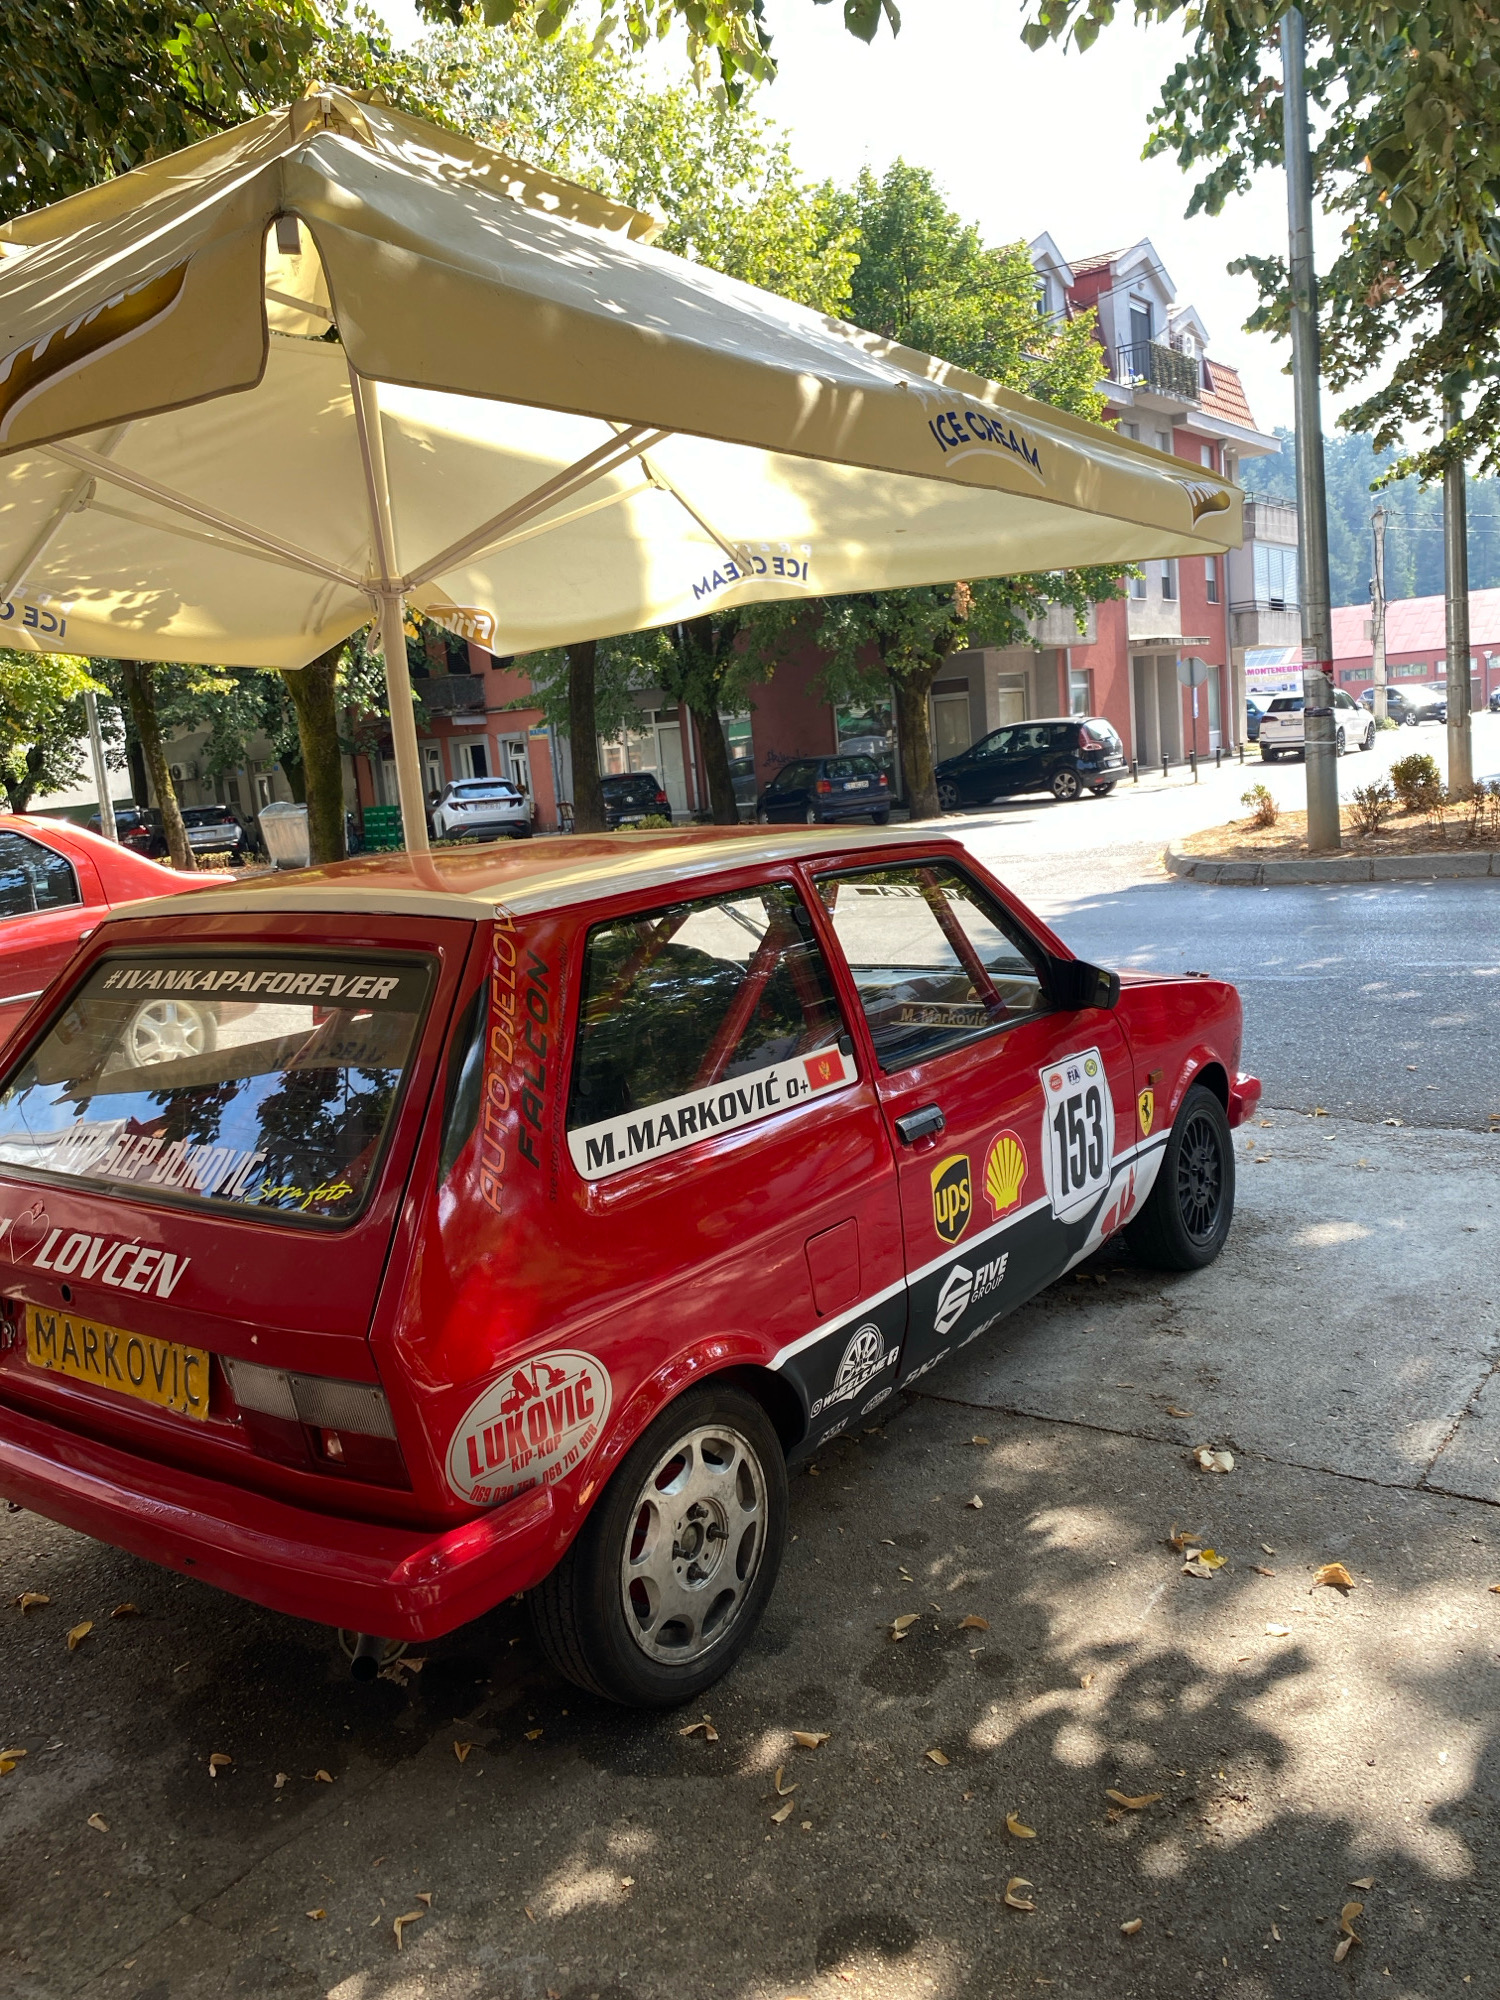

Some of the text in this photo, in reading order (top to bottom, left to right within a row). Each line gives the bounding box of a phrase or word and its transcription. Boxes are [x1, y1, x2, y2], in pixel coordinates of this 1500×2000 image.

[928, 411, 971, 453] ICE
[964, 411, 1044, 476] CREAM
[1245, 664, 1303, 676] MONTENEGRO
[103, 969, 400, 1000] #IVANKAPAFOREVER
[517, 950, 550, 1170] FALCON
[480, 1071, 511, 1214] AUTO
[585, 1071, 781, 1171] M.MARKOVIĆ
[1053, 1085, 1104, 1198] 153
[299, 1179, 353, 1211] foto
[33, 1228, 192, 1299] LOVĆEN
[970, 1274, 1005, 1304] GROUP
[974, 1252, 1010, 1291] FIVE
[466, 1368, 595, 1479] LUKOVIĆ
[511, 1434, 563, 1474] KIP-KOP
